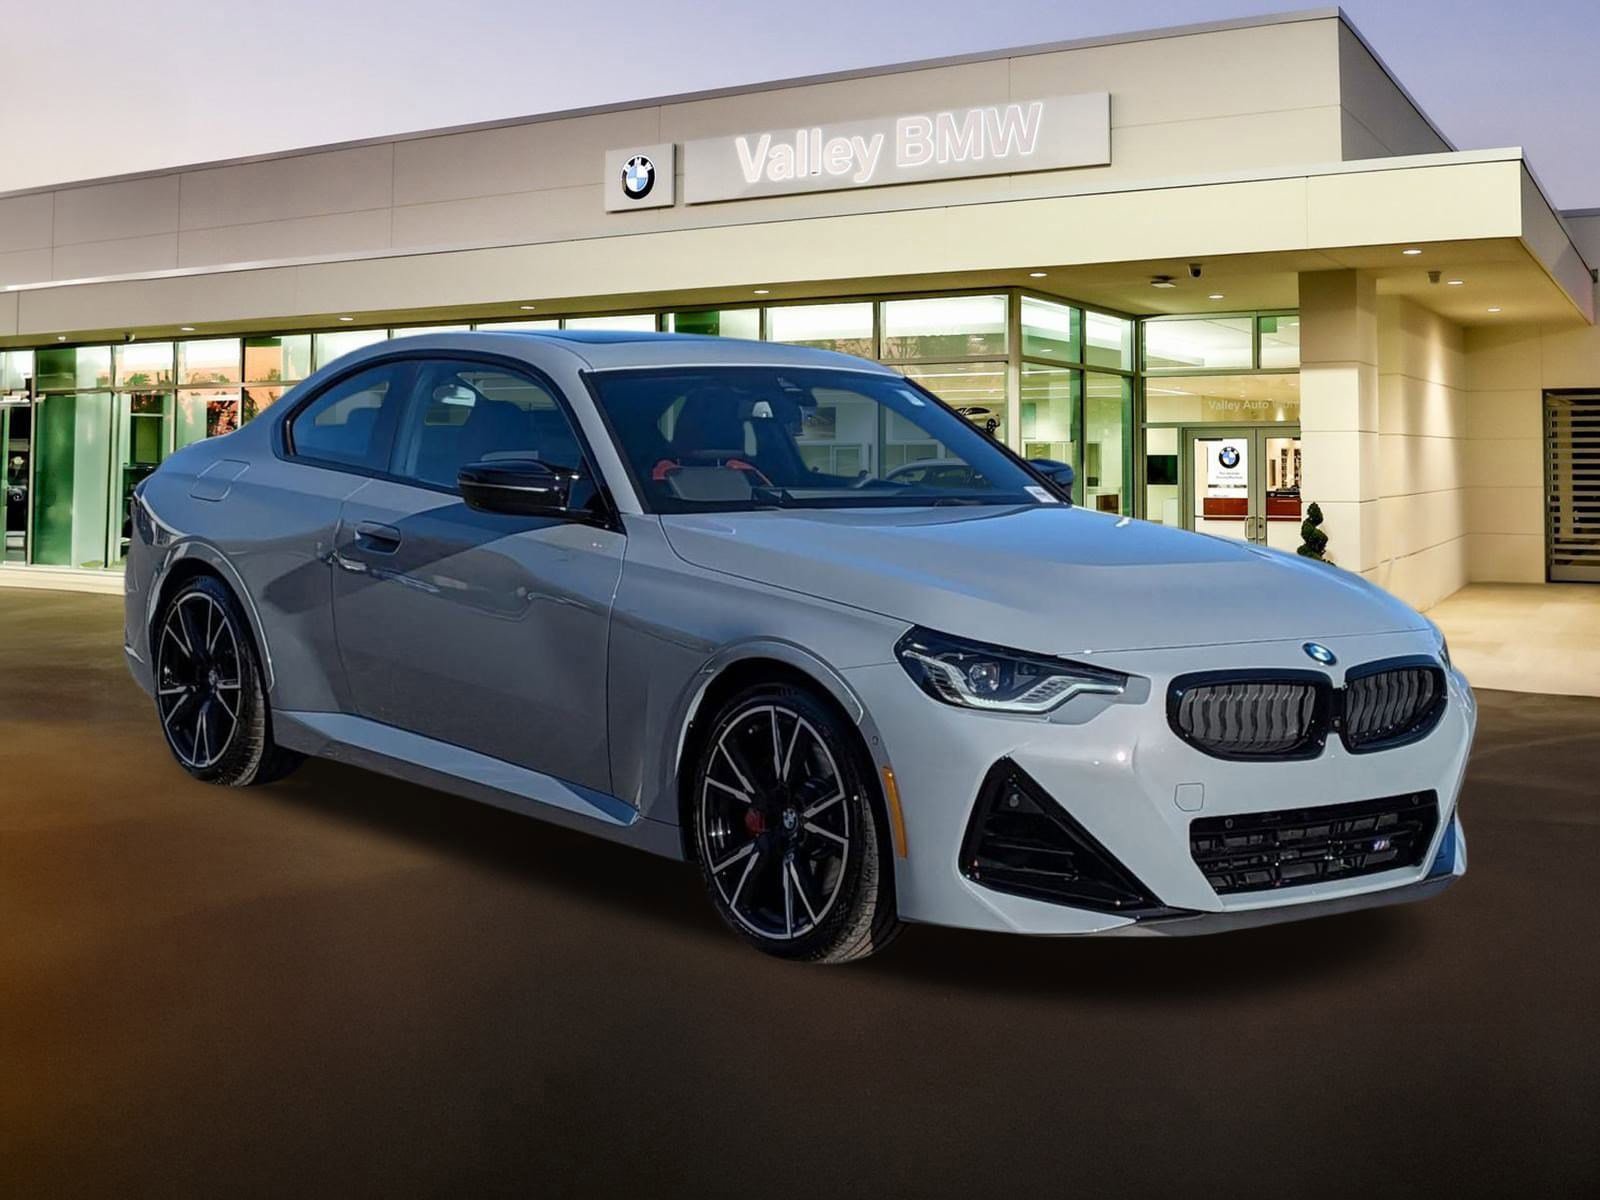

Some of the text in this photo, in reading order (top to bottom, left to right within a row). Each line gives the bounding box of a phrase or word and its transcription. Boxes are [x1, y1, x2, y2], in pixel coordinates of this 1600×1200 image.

[735, 102, 1043, 183] Valley BMW
[1208, 400, 1240, 413] Valley
[1243, 399, 1269, 409] Auto
